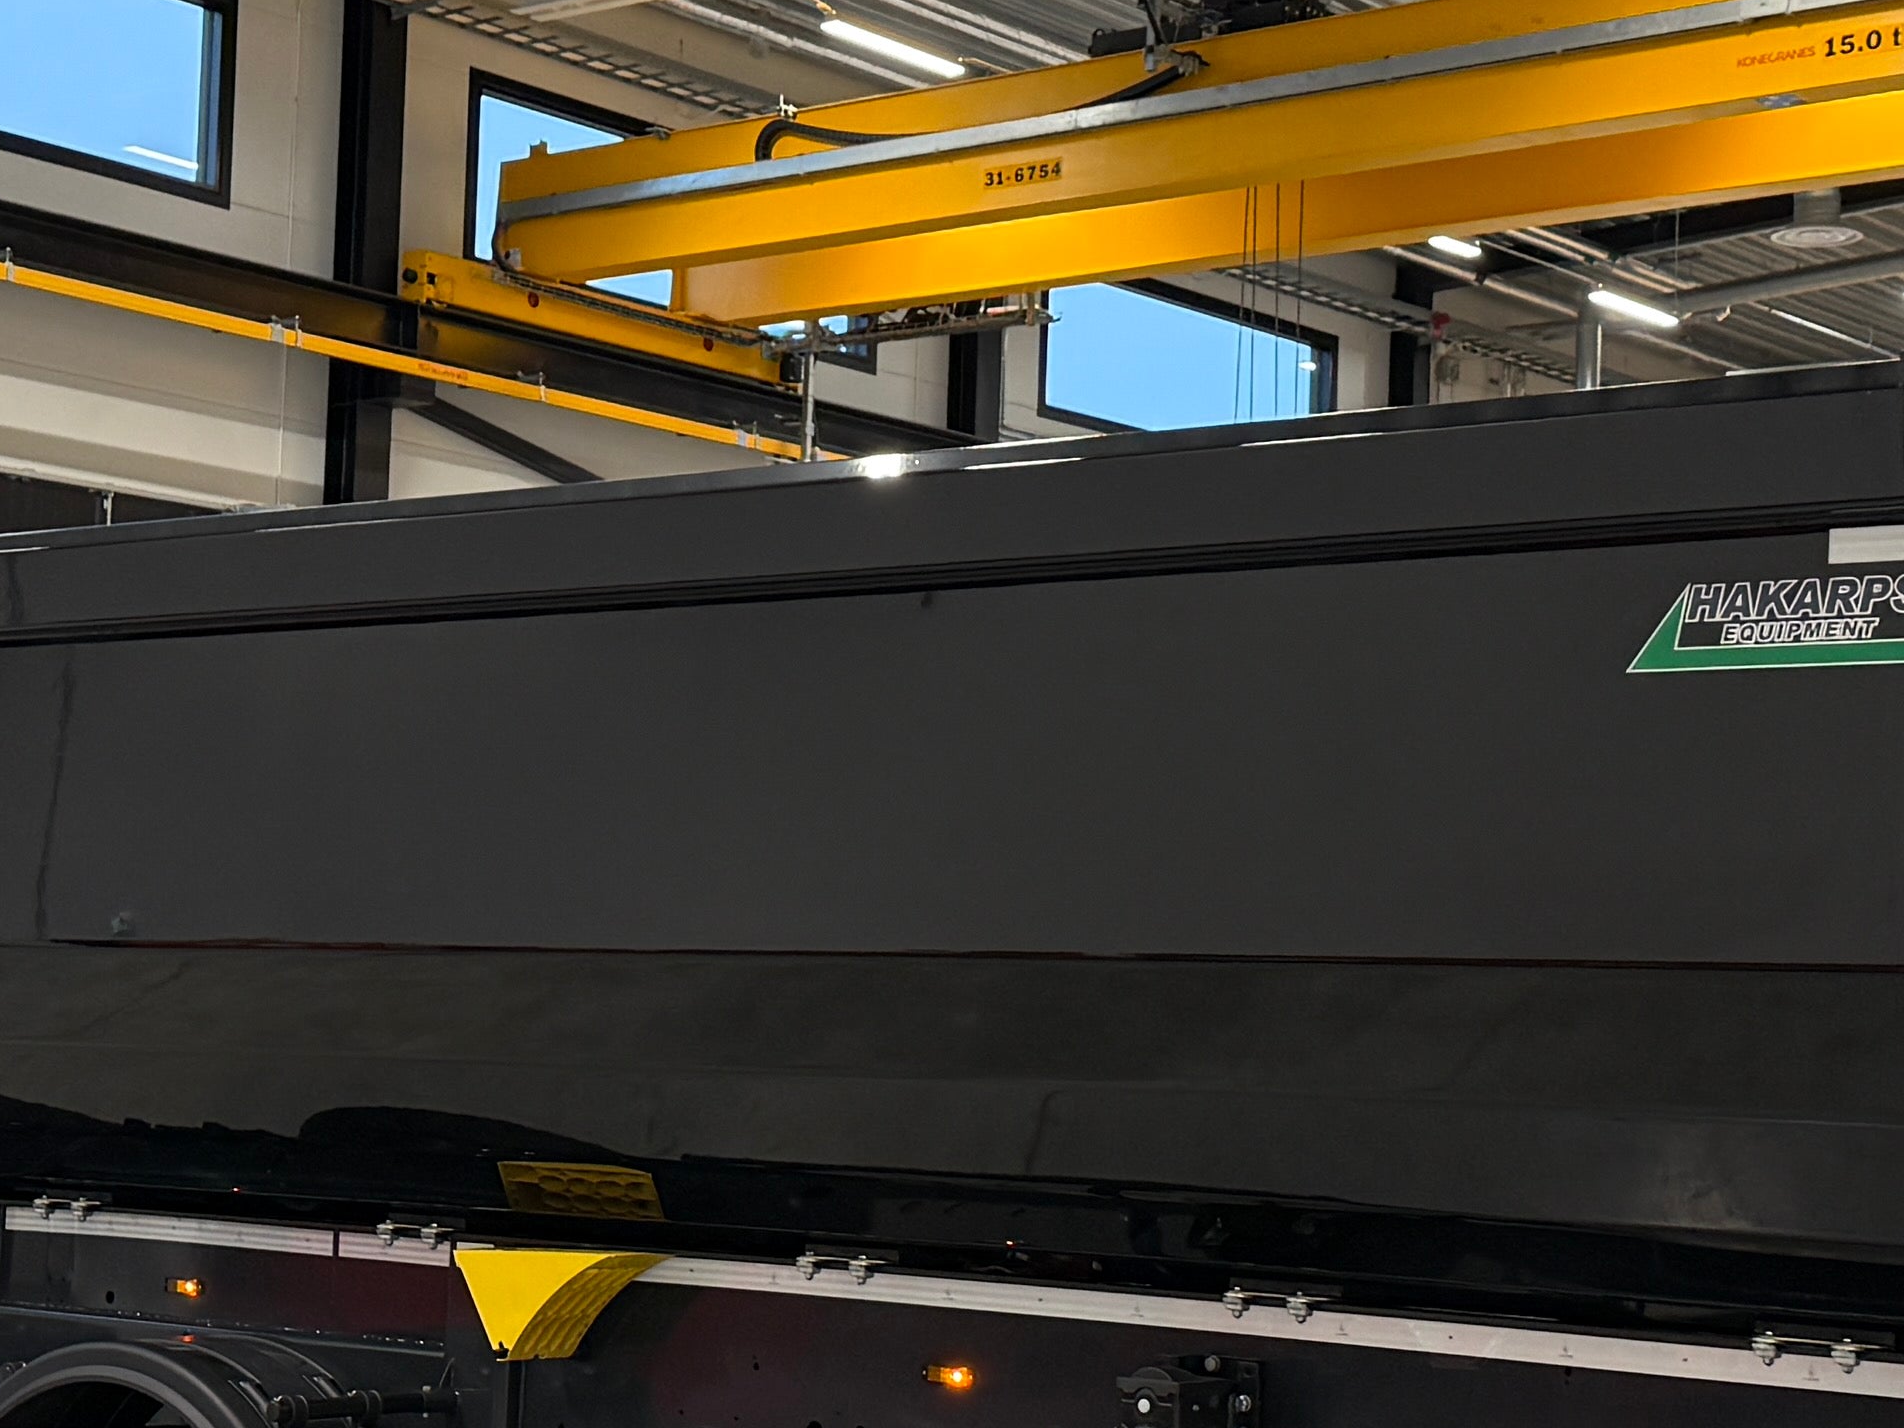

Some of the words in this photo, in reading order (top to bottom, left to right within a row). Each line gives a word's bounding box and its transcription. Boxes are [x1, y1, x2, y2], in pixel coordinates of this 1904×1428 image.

[1736, 45, 1817, 69] KONECRANES
[1824, 29, 1883, 58] 15.0
[1892, 27, 1903, 47] t
[1720, 617, 1881, 645] EQUIPMENT
